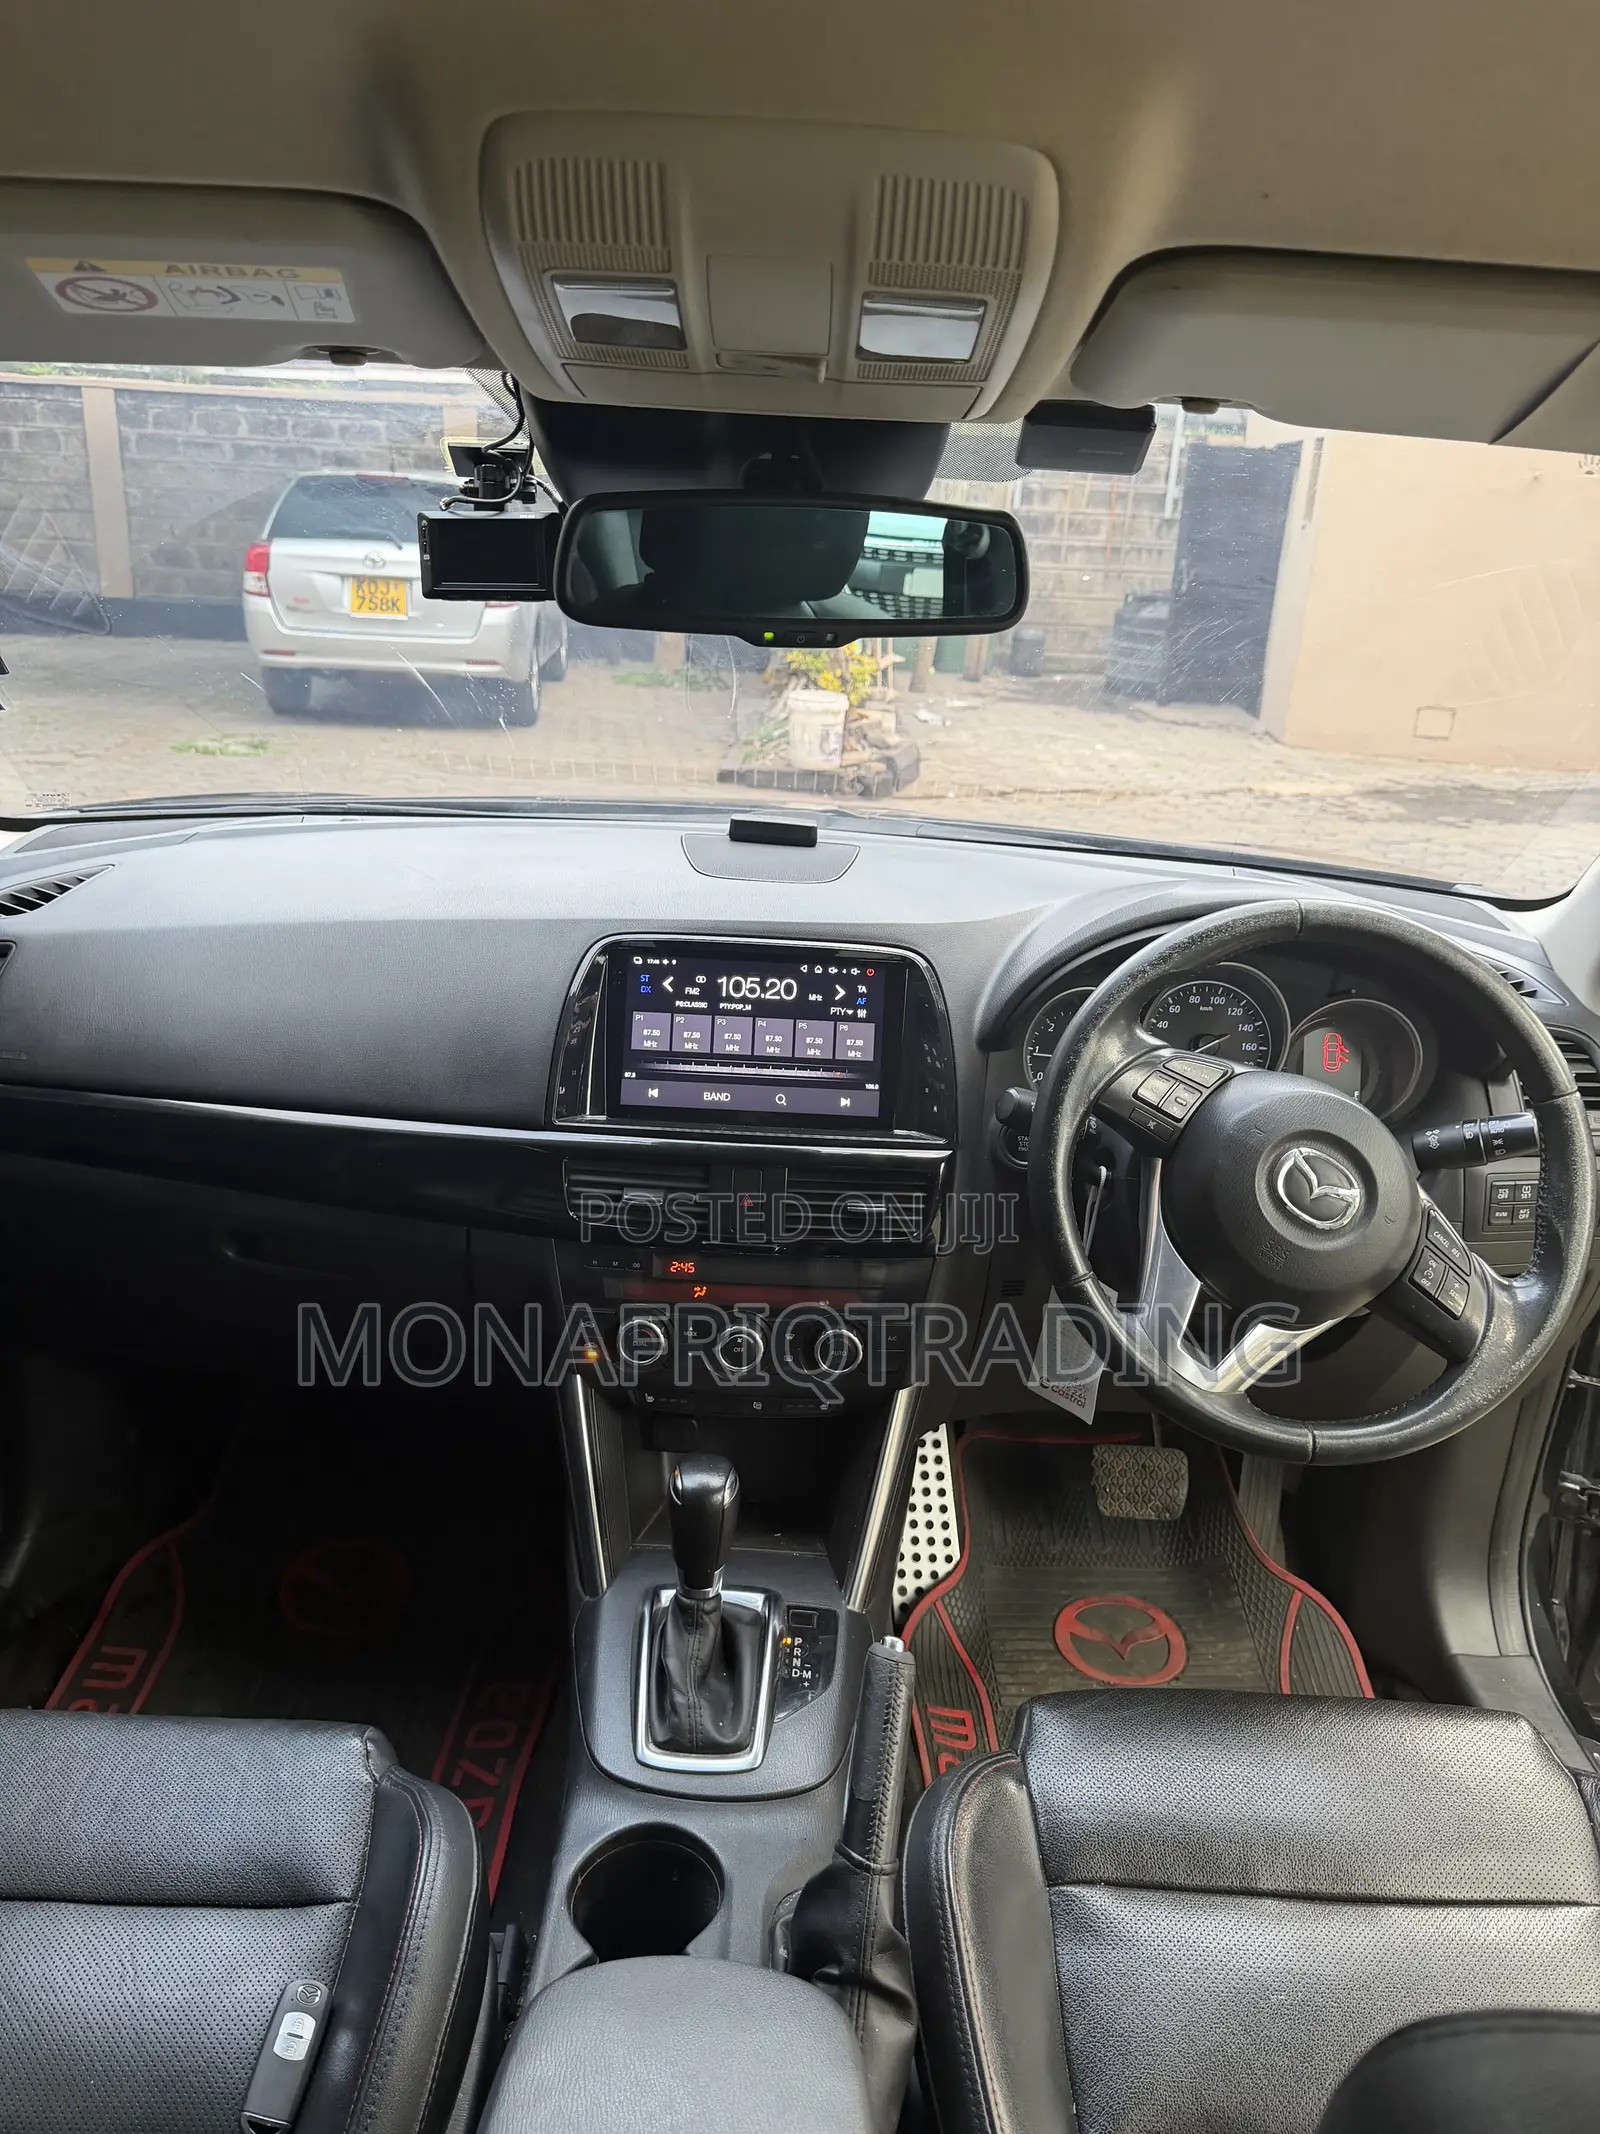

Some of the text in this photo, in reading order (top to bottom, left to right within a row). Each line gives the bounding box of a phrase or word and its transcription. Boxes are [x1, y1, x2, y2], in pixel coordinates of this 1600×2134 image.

[164, 262, 300, 280] AIRBAG
[640, 974, 651, 982] ST
[640, 985, 652, 994] DX
[684, 986, 701, 996] FM2
[717, 975, 798, 1001] 105.20
[857, 985, 868, 994] TA
[808, 993, 823, 1002] MHz
[856, 997, 867, 1005] AF
[1189, 995, 1200, 1004] 80
[1210, 996, 1226, 1005] 100
[830, 1006, 847, 1016] PTY
[1169, 1005, 1181, 1014] 60
[1227, 1007, 1243, 1016] 120
[635, 1014, 645, 1022] P1
[675, 1016, 685, 1024] P2
[717, 1018, 727, 1026] P3
[758, 1020, 768, 1028] P4
[799, 1022, 809, 1030] P5
[1047, 1022, 1055, 1032] 2
[1156, 1020, 1169, 1029] 40
[1238, 1023, 1254, 1032] 140
[643, 1028, 661, 1037] 87.50
[683, 1030, 701, 1039] 87.50
[724, 1032, 742, 1041] 87.50
[765, 1034, 783, 1043] 87.50
[806, 1036, 824, 1045] 87.50
[846, 1038, 864, 1047] 87.50
[643, 1040, 659, 1048] MHz
[684, 1042, 700, 1050] MHz
[725, 1044, 741, 1052] MHz
[1241, 1042, 1258, 1051] 160
[766, 1046, 782, 1054] MHz
[807, 1048, 823, 1056] MHz
[847, 1050, 863, 1058] MHz
[1034, 1045, 1040, 1054] 1
[1036, 1071, 1044, 1081] 0
[703, 1091, 731, 1102] BAND
[1433, 1230, 1462, 1258] CANCEL RES
[669, 1261, 696, 1273] 2:45
[1428, 1259, 1437, 1269] ON
[1420, 1278, 1432, 1287] OFF
[1051, 1384, 1087, 1409] Castrol
[794, 1636, 803, 1646] P
[793, 1647, 801, 1656] R
[792, 1657, 801, 1667] N
